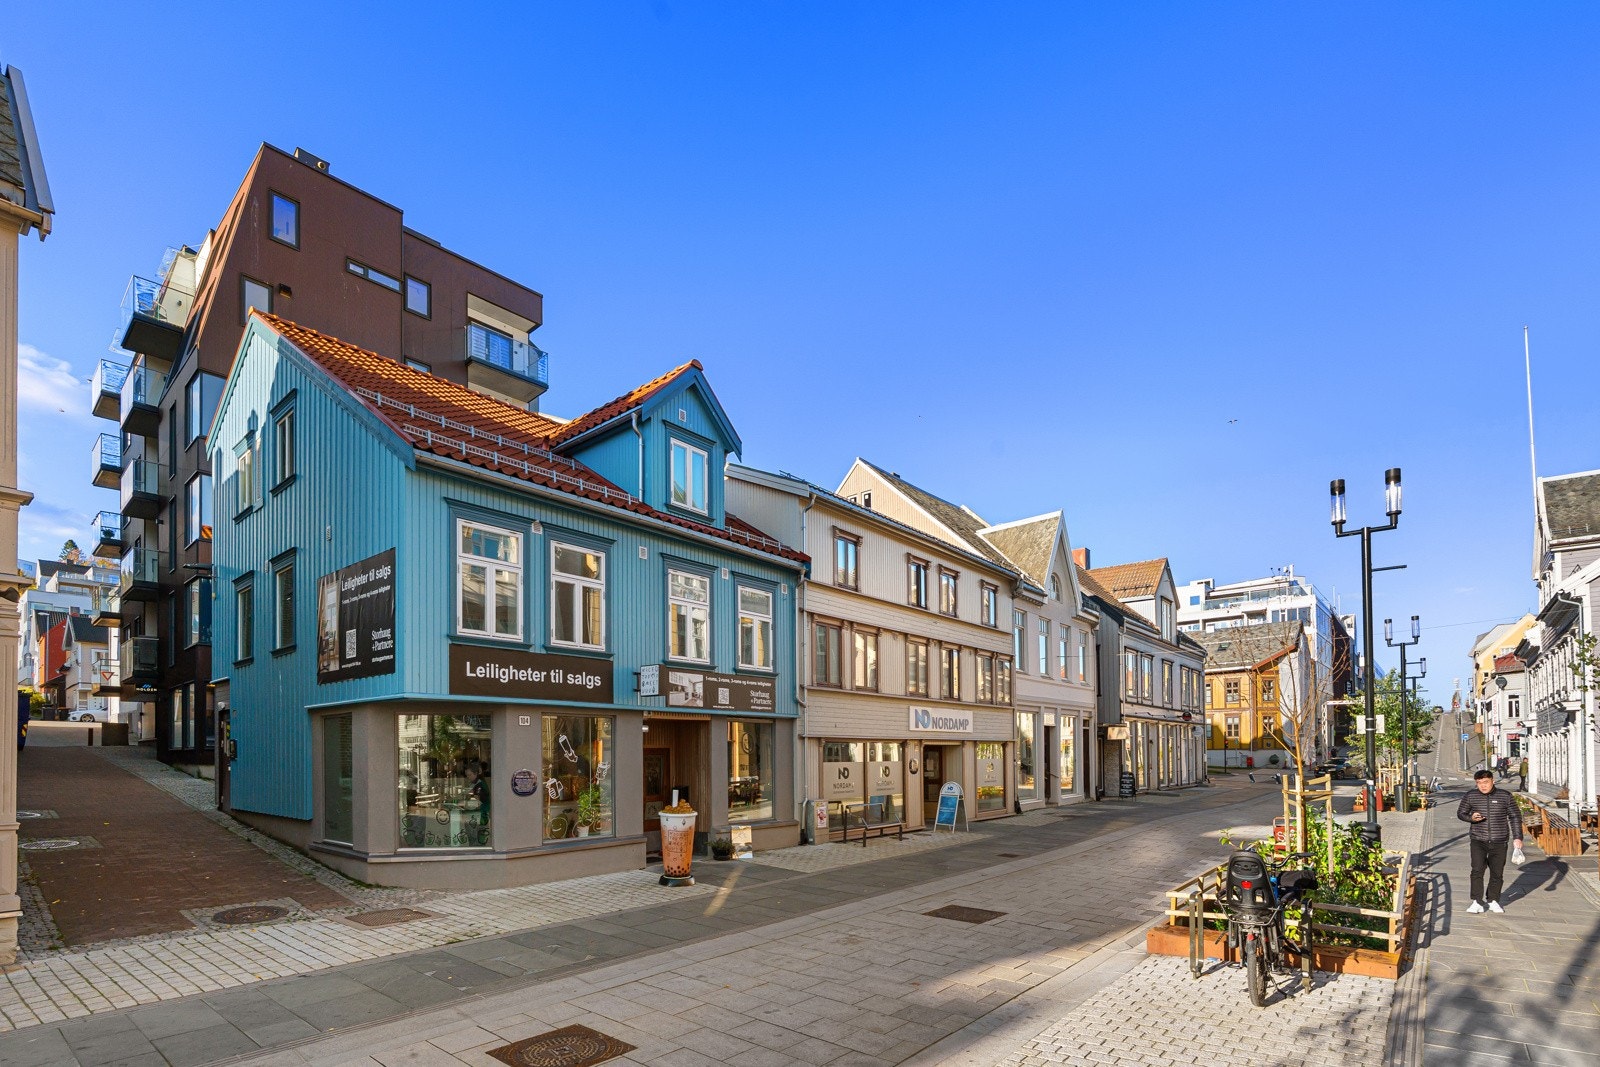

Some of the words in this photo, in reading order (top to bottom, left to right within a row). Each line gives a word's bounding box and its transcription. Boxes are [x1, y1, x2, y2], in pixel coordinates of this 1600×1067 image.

[341, 573, 368, 592] Leiligheter
[376, 565, 391, 579] salgs
[466, 661, 547, 683] Leiligheter
[550, 669, 563, 684] til
[567, 672, 602, 689] salgs
[932, 716, 969, 731] NORDAMP
